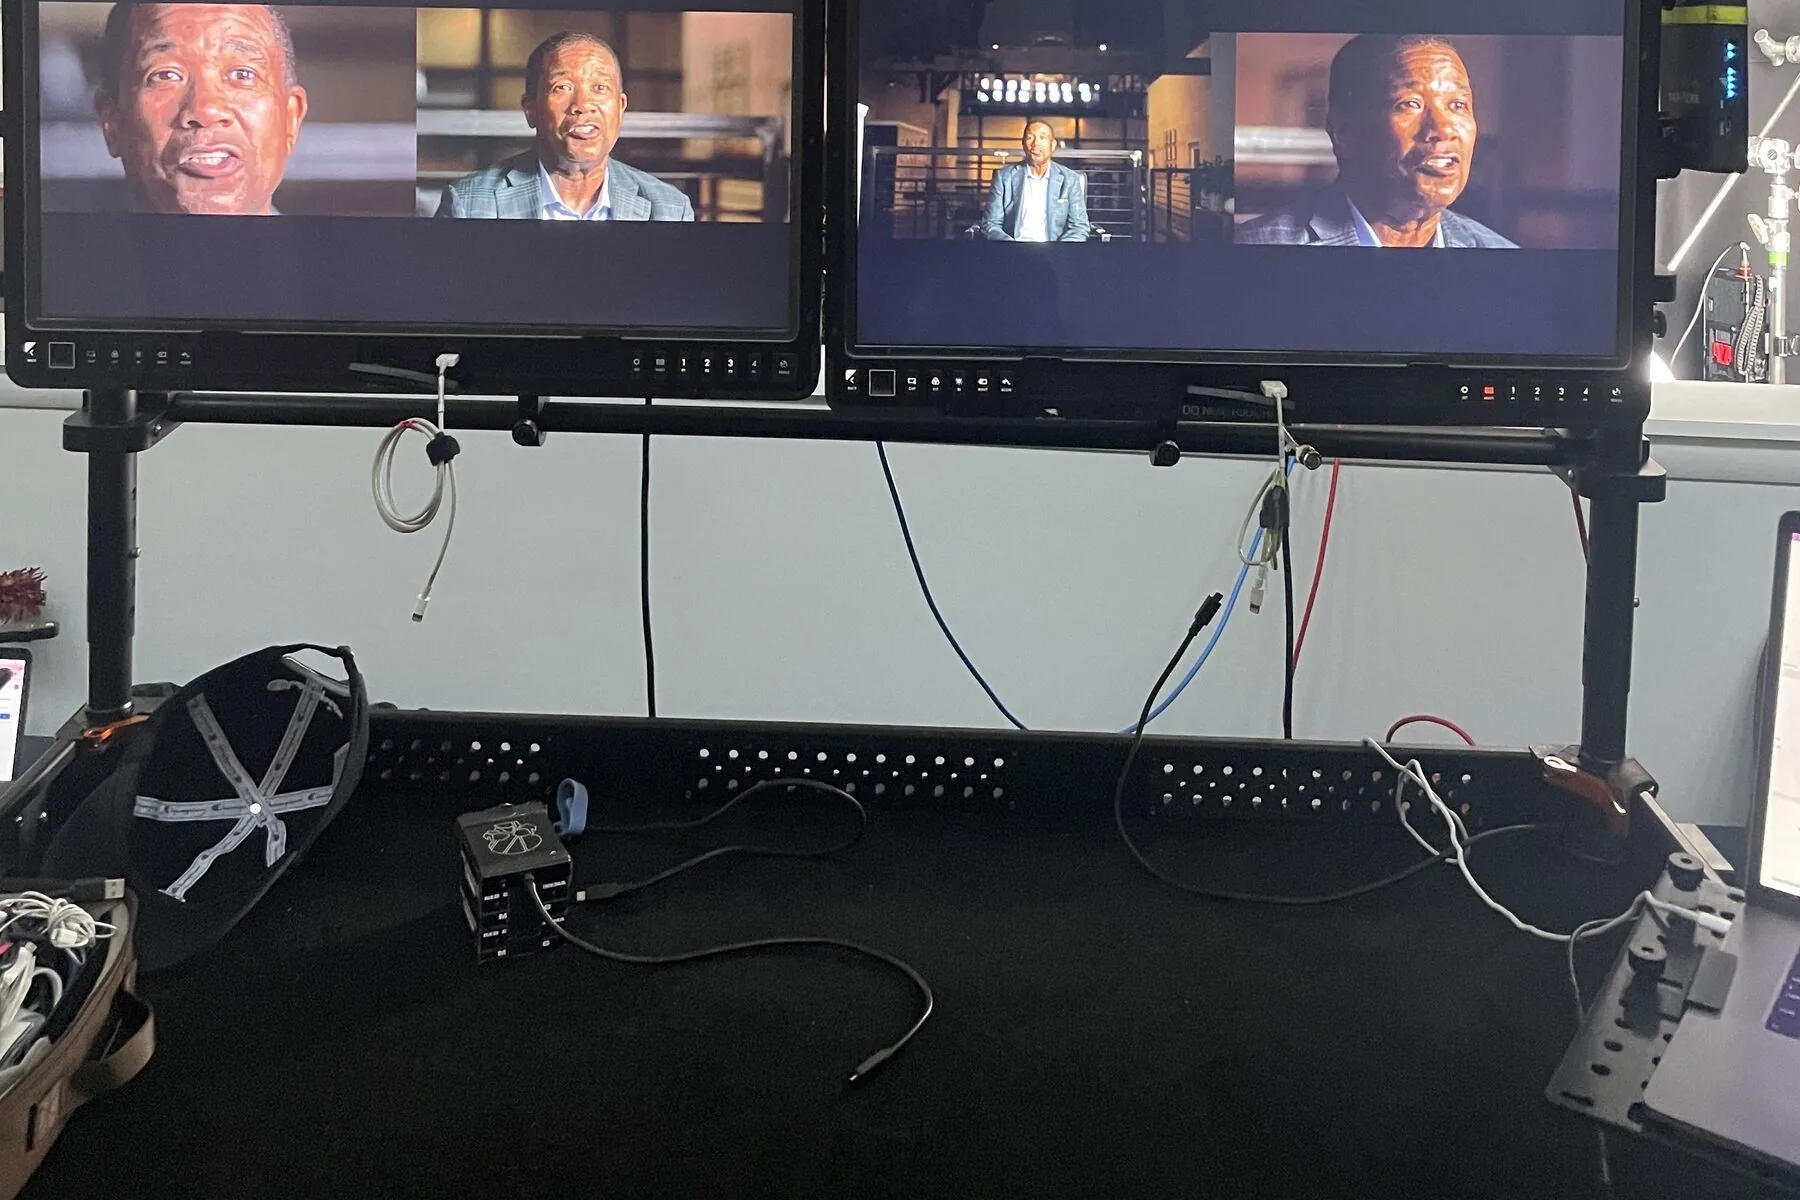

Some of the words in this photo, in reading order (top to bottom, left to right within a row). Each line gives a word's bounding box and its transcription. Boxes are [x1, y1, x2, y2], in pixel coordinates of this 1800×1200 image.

[704, 358, 711, 367] 2
[727, 358, 734, 368] 3
[751, 359, 757, 367] 4
[1534, 386, 1541, 395] 2
[1558, 387, 1565, 396] 3
[1582, 387, 1589, 396] 4
